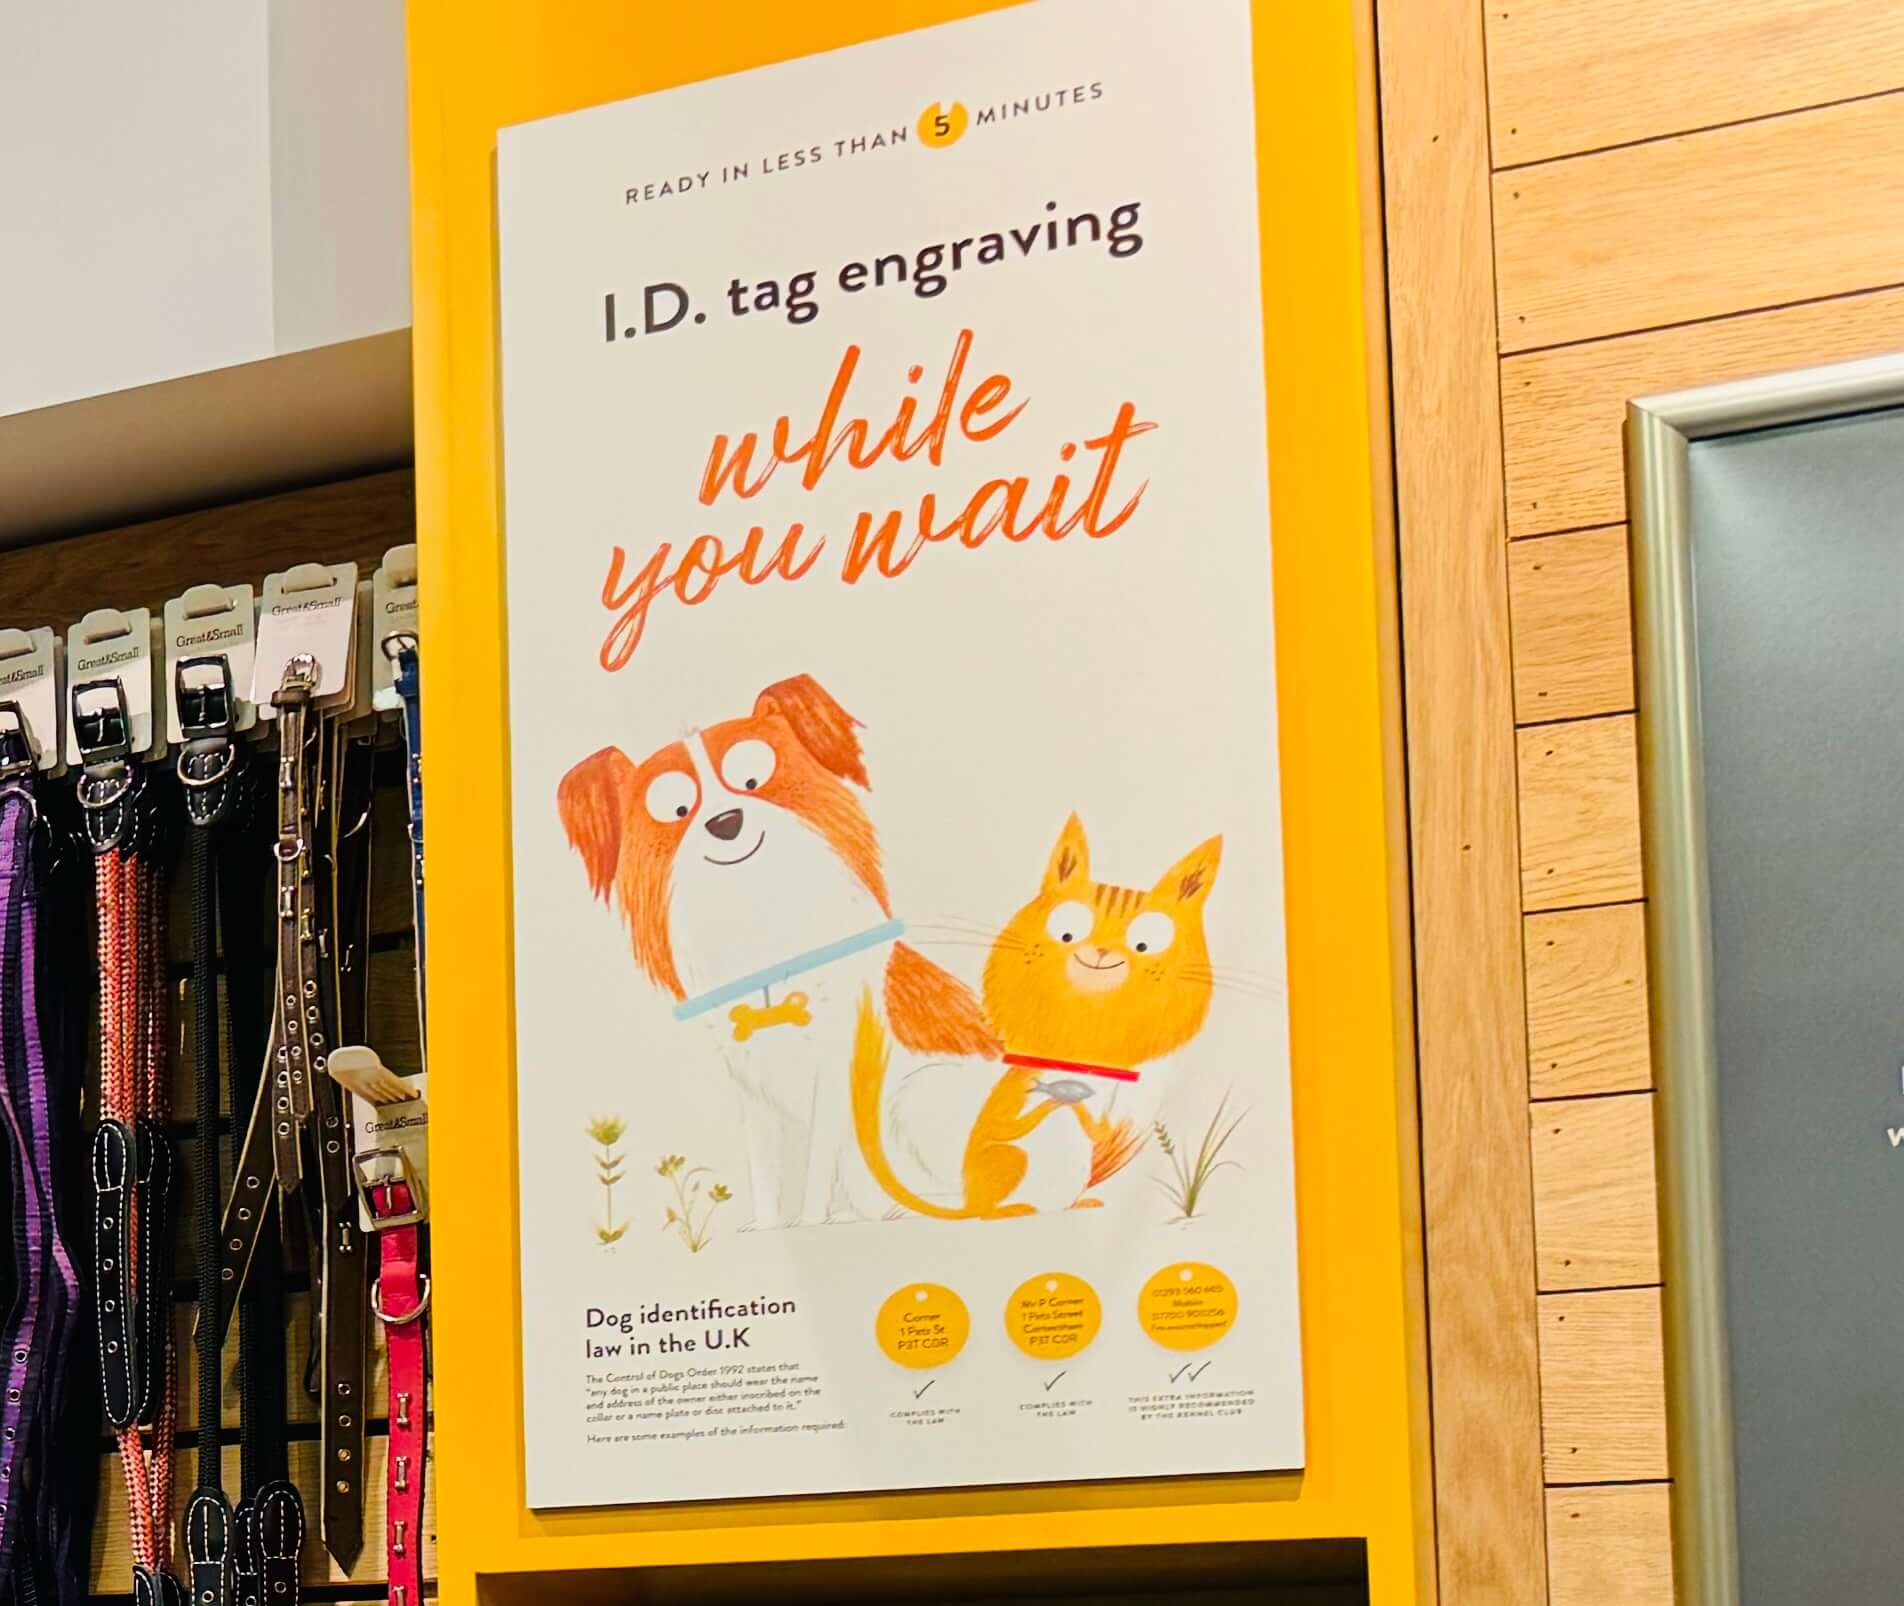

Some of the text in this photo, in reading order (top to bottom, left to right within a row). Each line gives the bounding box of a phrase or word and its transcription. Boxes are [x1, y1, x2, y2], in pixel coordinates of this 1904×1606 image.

[625, 82, 1105, 205] READY IN LESS THAN 5 MINUTES
[603, 201, 1143, 342] I.D. tag engraving
[698, 328, 1030, 506] while
[600, 402, 1158, 671] you wait
[271, 597, 342, 617] Great&Small
[176, 624, 243, 648] Great&Small
[77, 647, 139, 672] Great&Small
[586, 1296, 796, 1333] Dog identification
[904, 1313, 941, 1323] Corner
[586, 1327, 751, 1359] law in the U.K
[606, 1373, 643, 1383] Control
[660, 1370, 684, 1382] Dogs
[687, 1368, 717, 1378] Order
[720, 1365, 744, 1375] 1992
[779, 1362, 799, 1371] that
[651, 1383, 679, 1396] public
[682, 1382, 707, 1393] place
[711, 1379, 742, 1389] should
[606, 1398, 642, 1409] address
[665, 1408, 689, 1420] plate
